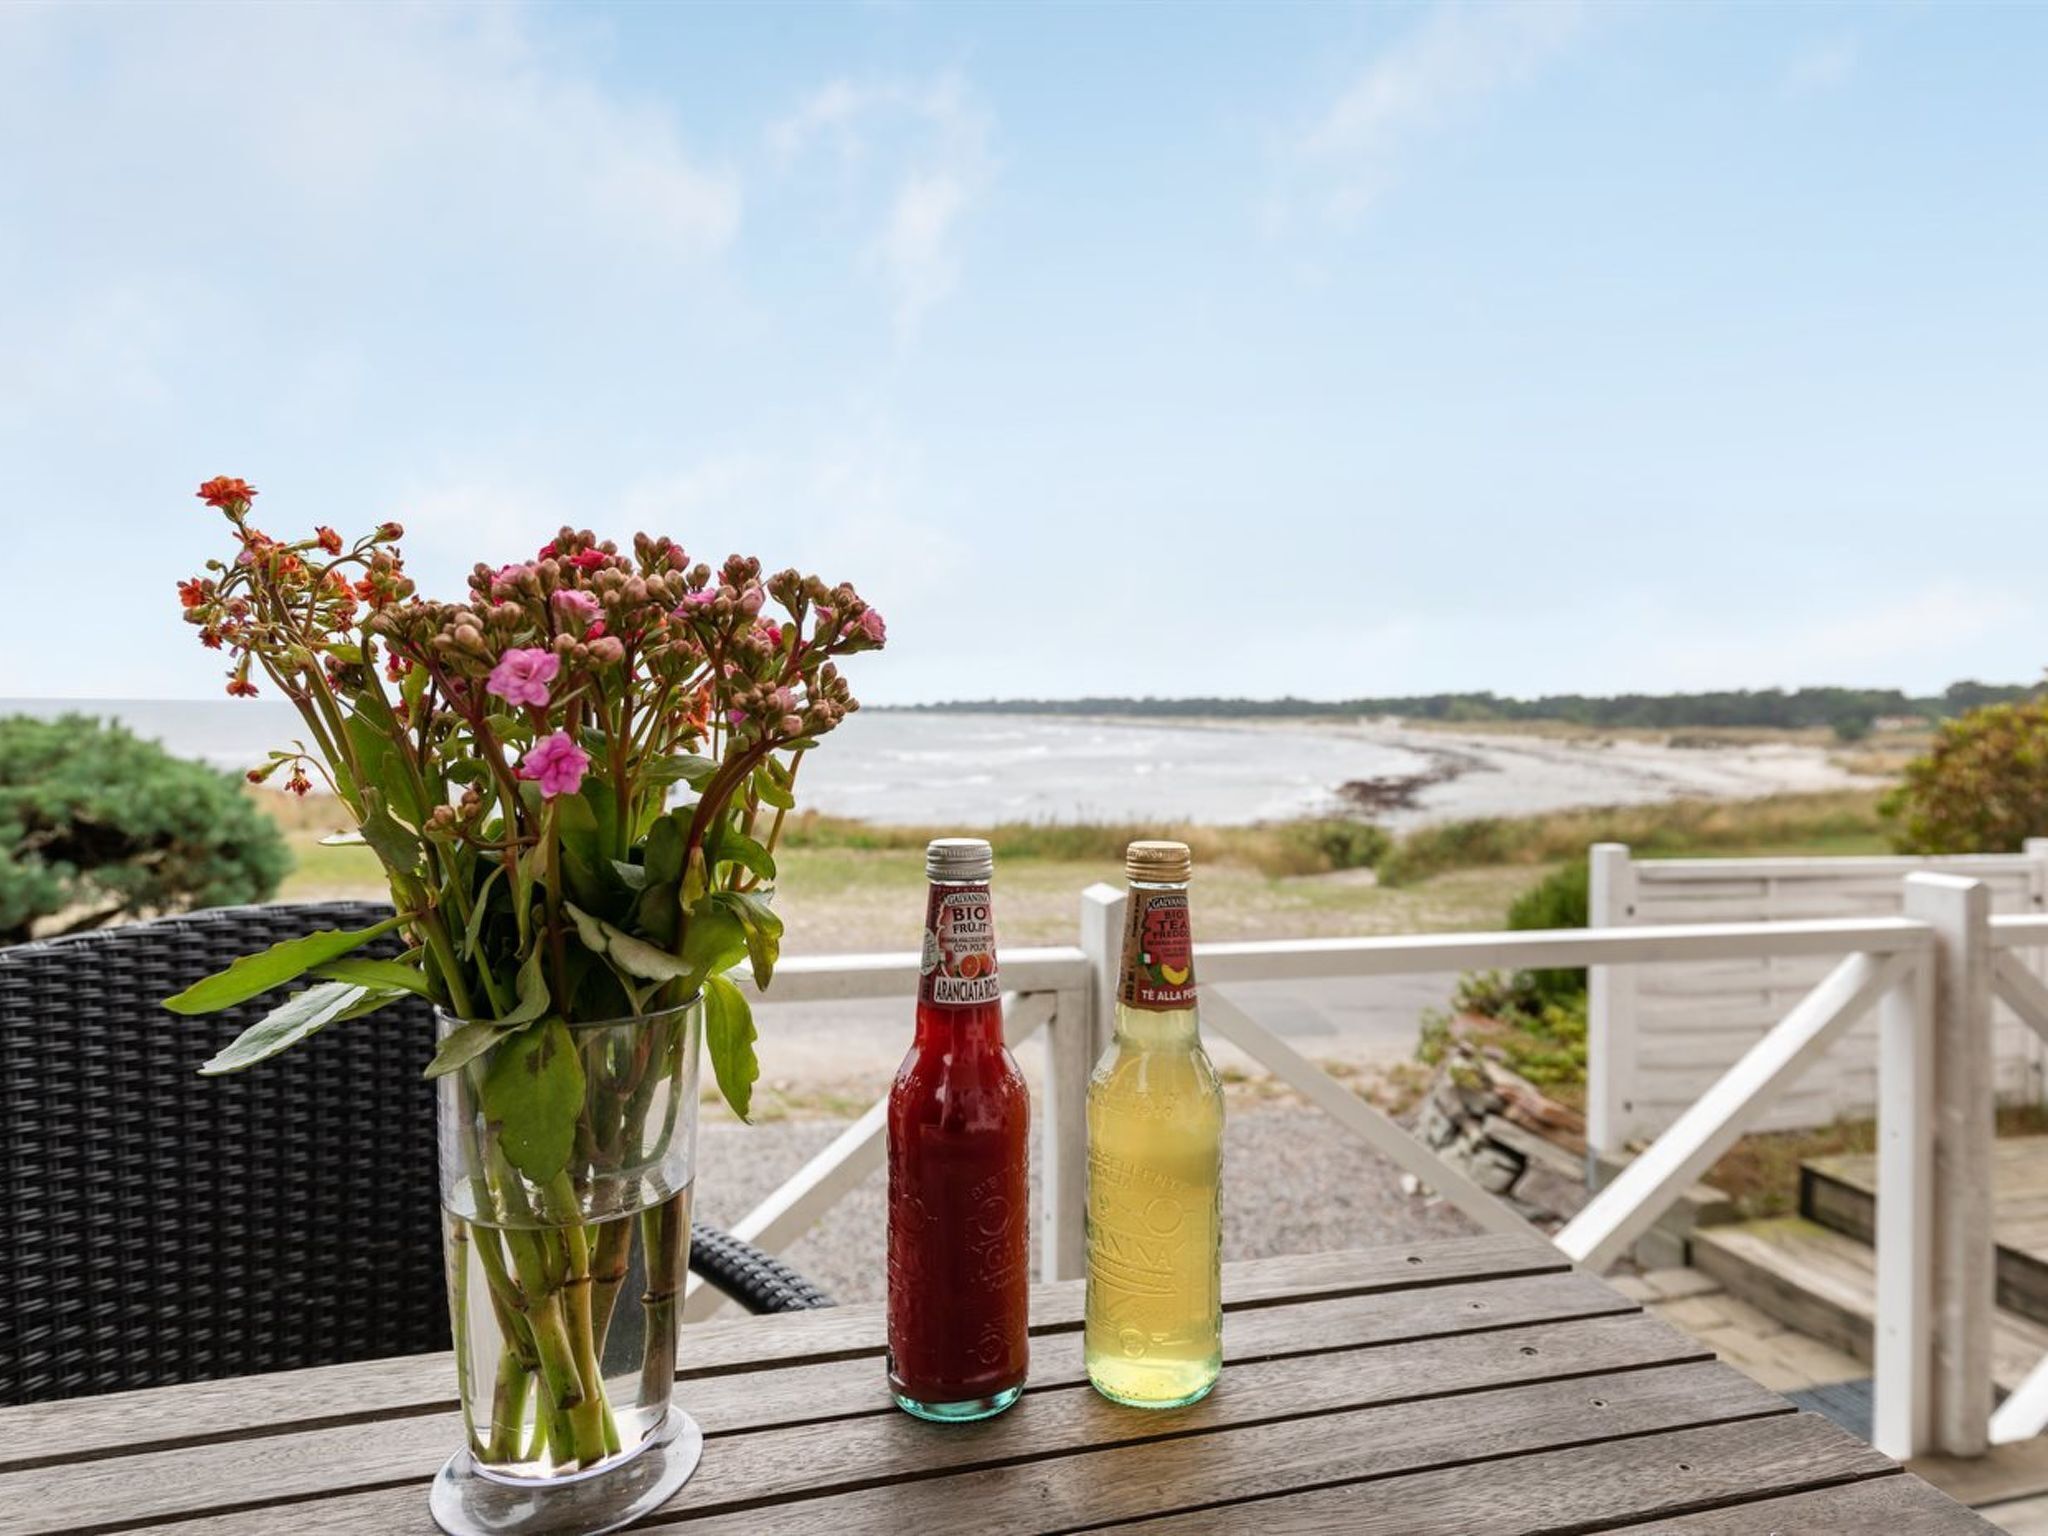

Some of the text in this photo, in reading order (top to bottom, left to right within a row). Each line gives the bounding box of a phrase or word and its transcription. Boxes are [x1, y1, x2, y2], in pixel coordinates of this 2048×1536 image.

[952, 907, 986, 921] BIO
[1165, 911, 1184, 920] BIO
[1157, 920, 1188, 930] TEA
[936, 979, 984, 1001] ARANCIATA
[1157, 990, 1183, 1000] ALLA
